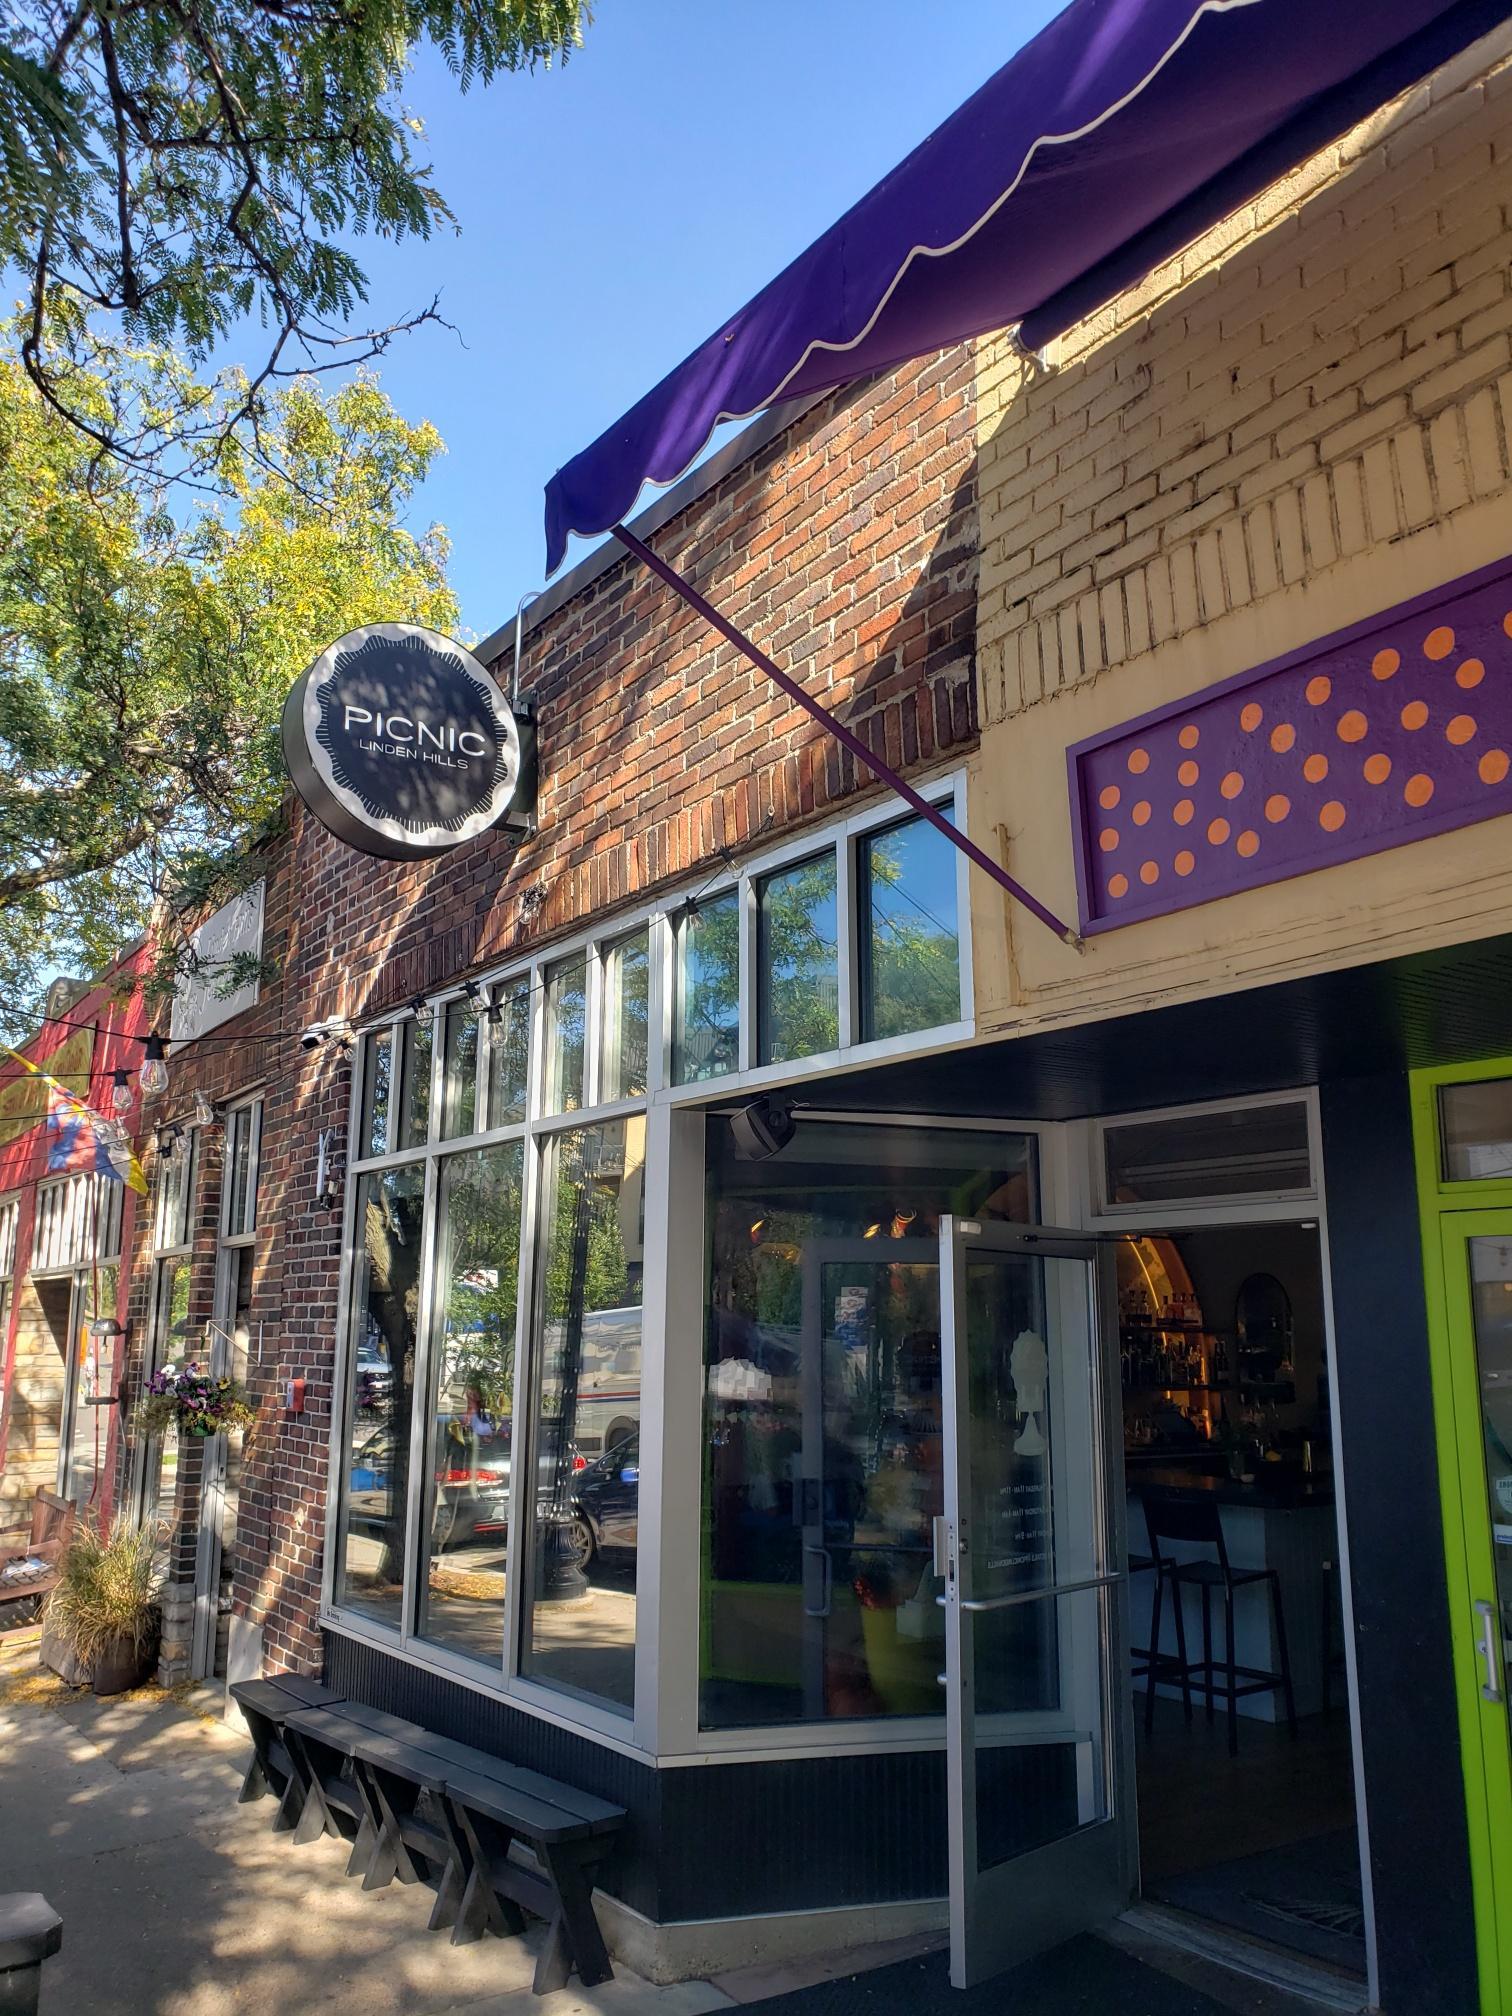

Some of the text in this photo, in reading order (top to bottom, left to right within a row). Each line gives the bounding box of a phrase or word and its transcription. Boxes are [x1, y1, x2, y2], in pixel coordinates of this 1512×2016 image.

[344, 705, 486, 756] PICNIC
[359, 738, 469, 770] LINDEN HILLS
